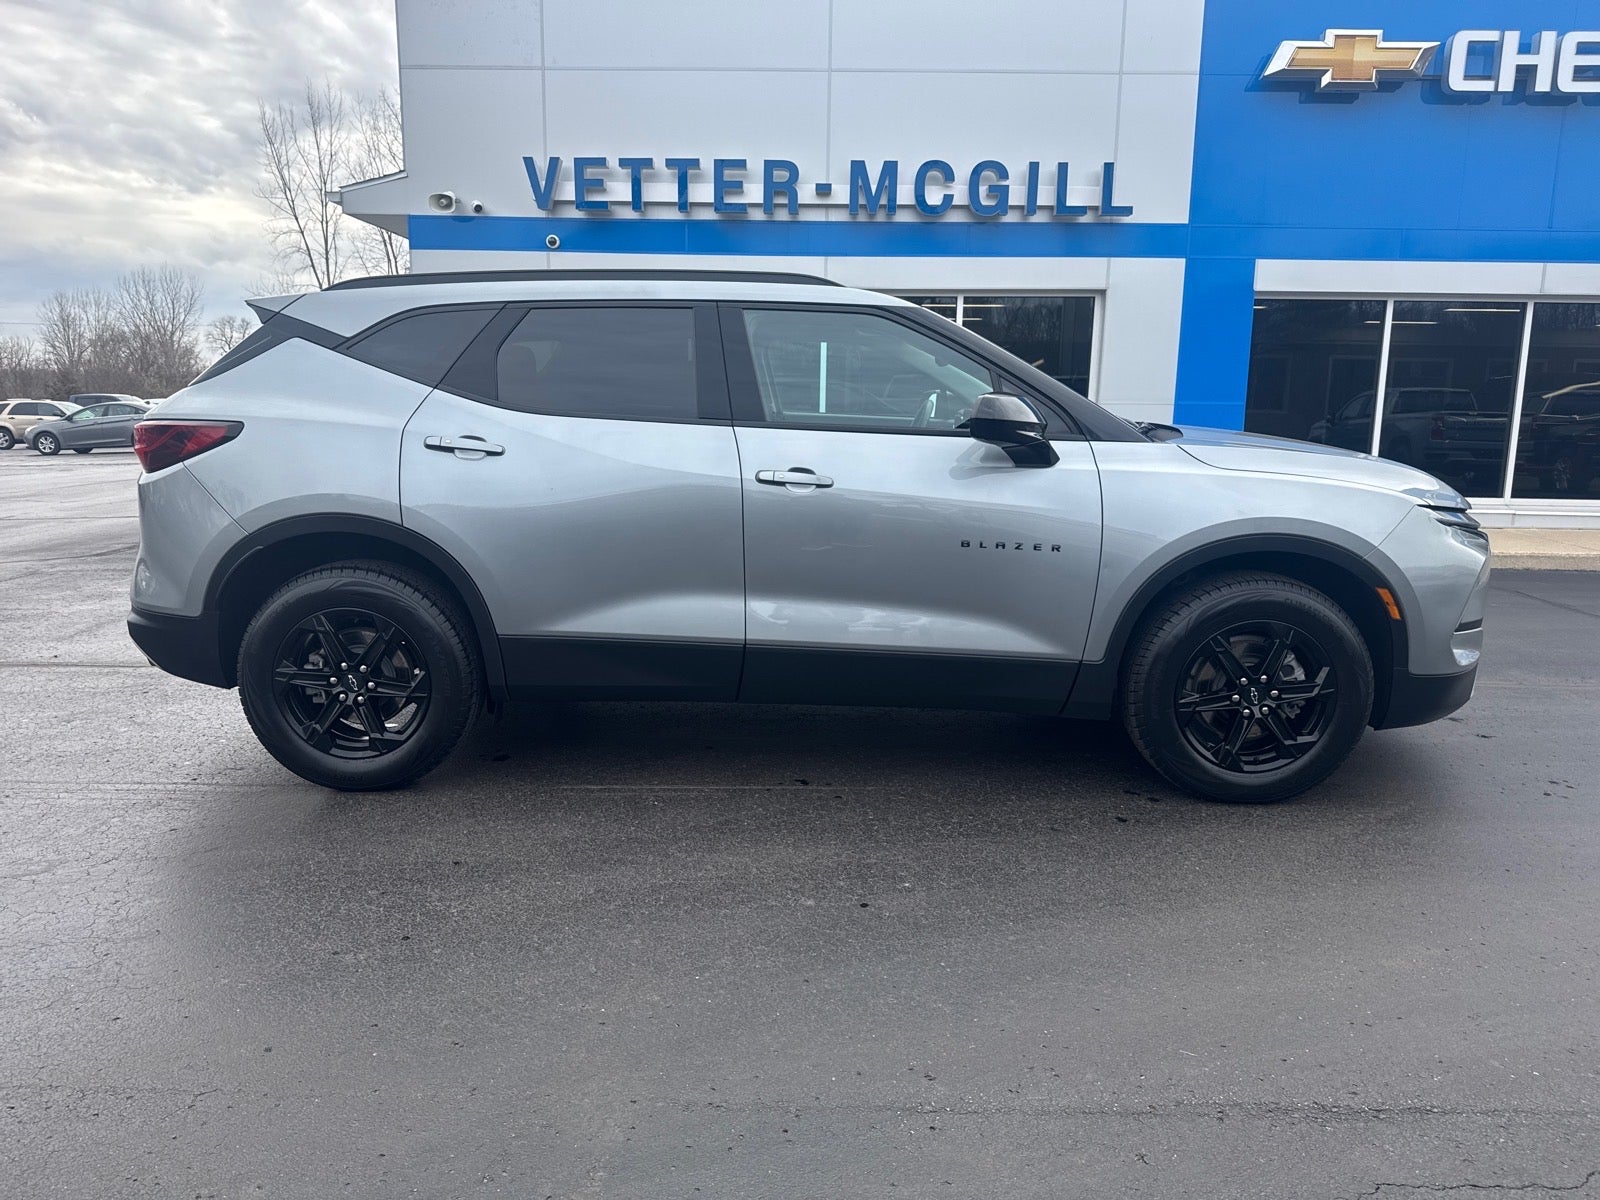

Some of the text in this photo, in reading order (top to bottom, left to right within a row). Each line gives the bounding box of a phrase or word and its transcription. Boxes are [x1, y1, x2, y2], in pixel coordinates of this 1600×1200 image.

[1447, 29, 1600, 95] CHE
[522, 156, 1134, 217] VETTER-MCGILL
[960, 540, 1063, 553] BLAZER
